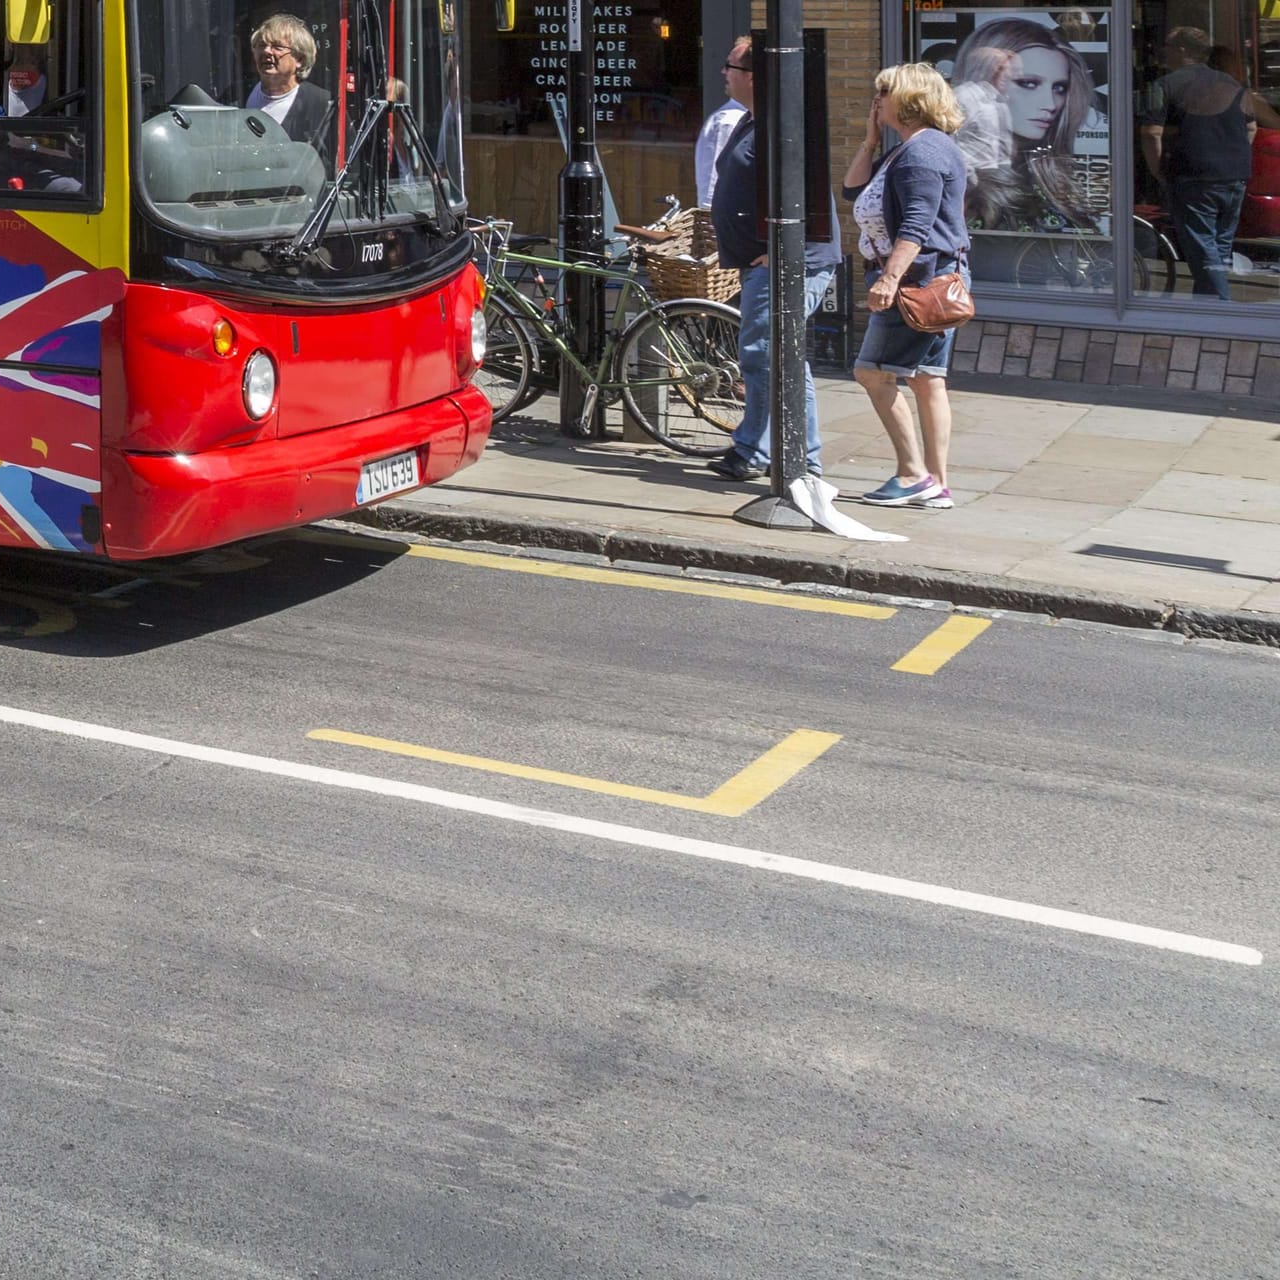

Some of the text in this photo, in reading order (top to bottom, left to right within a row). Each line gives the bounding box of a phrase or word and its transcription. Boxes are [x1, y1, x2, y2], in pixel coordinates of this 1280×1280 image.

[597, 58, 637, 69] BEER
[362, 242, 384, 263] 17078
[366, 455, 414, 497] TSU 639
